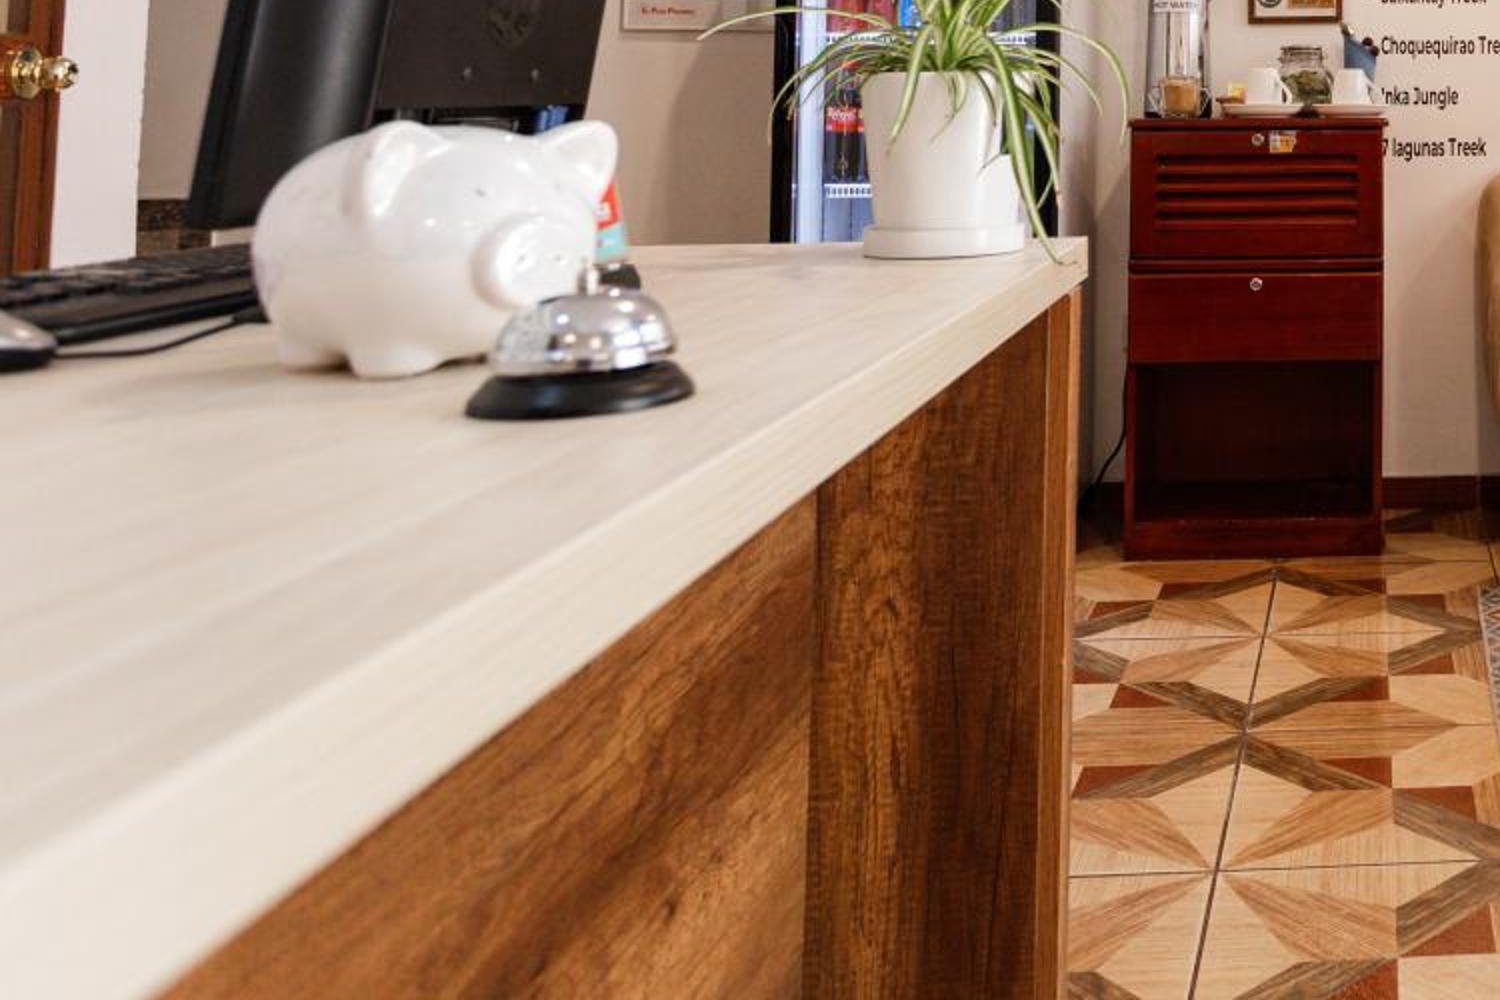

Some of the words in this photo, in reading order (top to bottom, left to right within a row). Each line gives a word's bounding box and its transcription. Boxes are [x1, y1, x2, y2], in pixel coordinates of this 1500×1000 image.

[1381, 35, 1475, 60] Choquequirao
[1412, 86, 1460, 110] Jungle
[1391, 138, 1445, 162] lagunas
[1447, 137, 1488, 157] Treek
